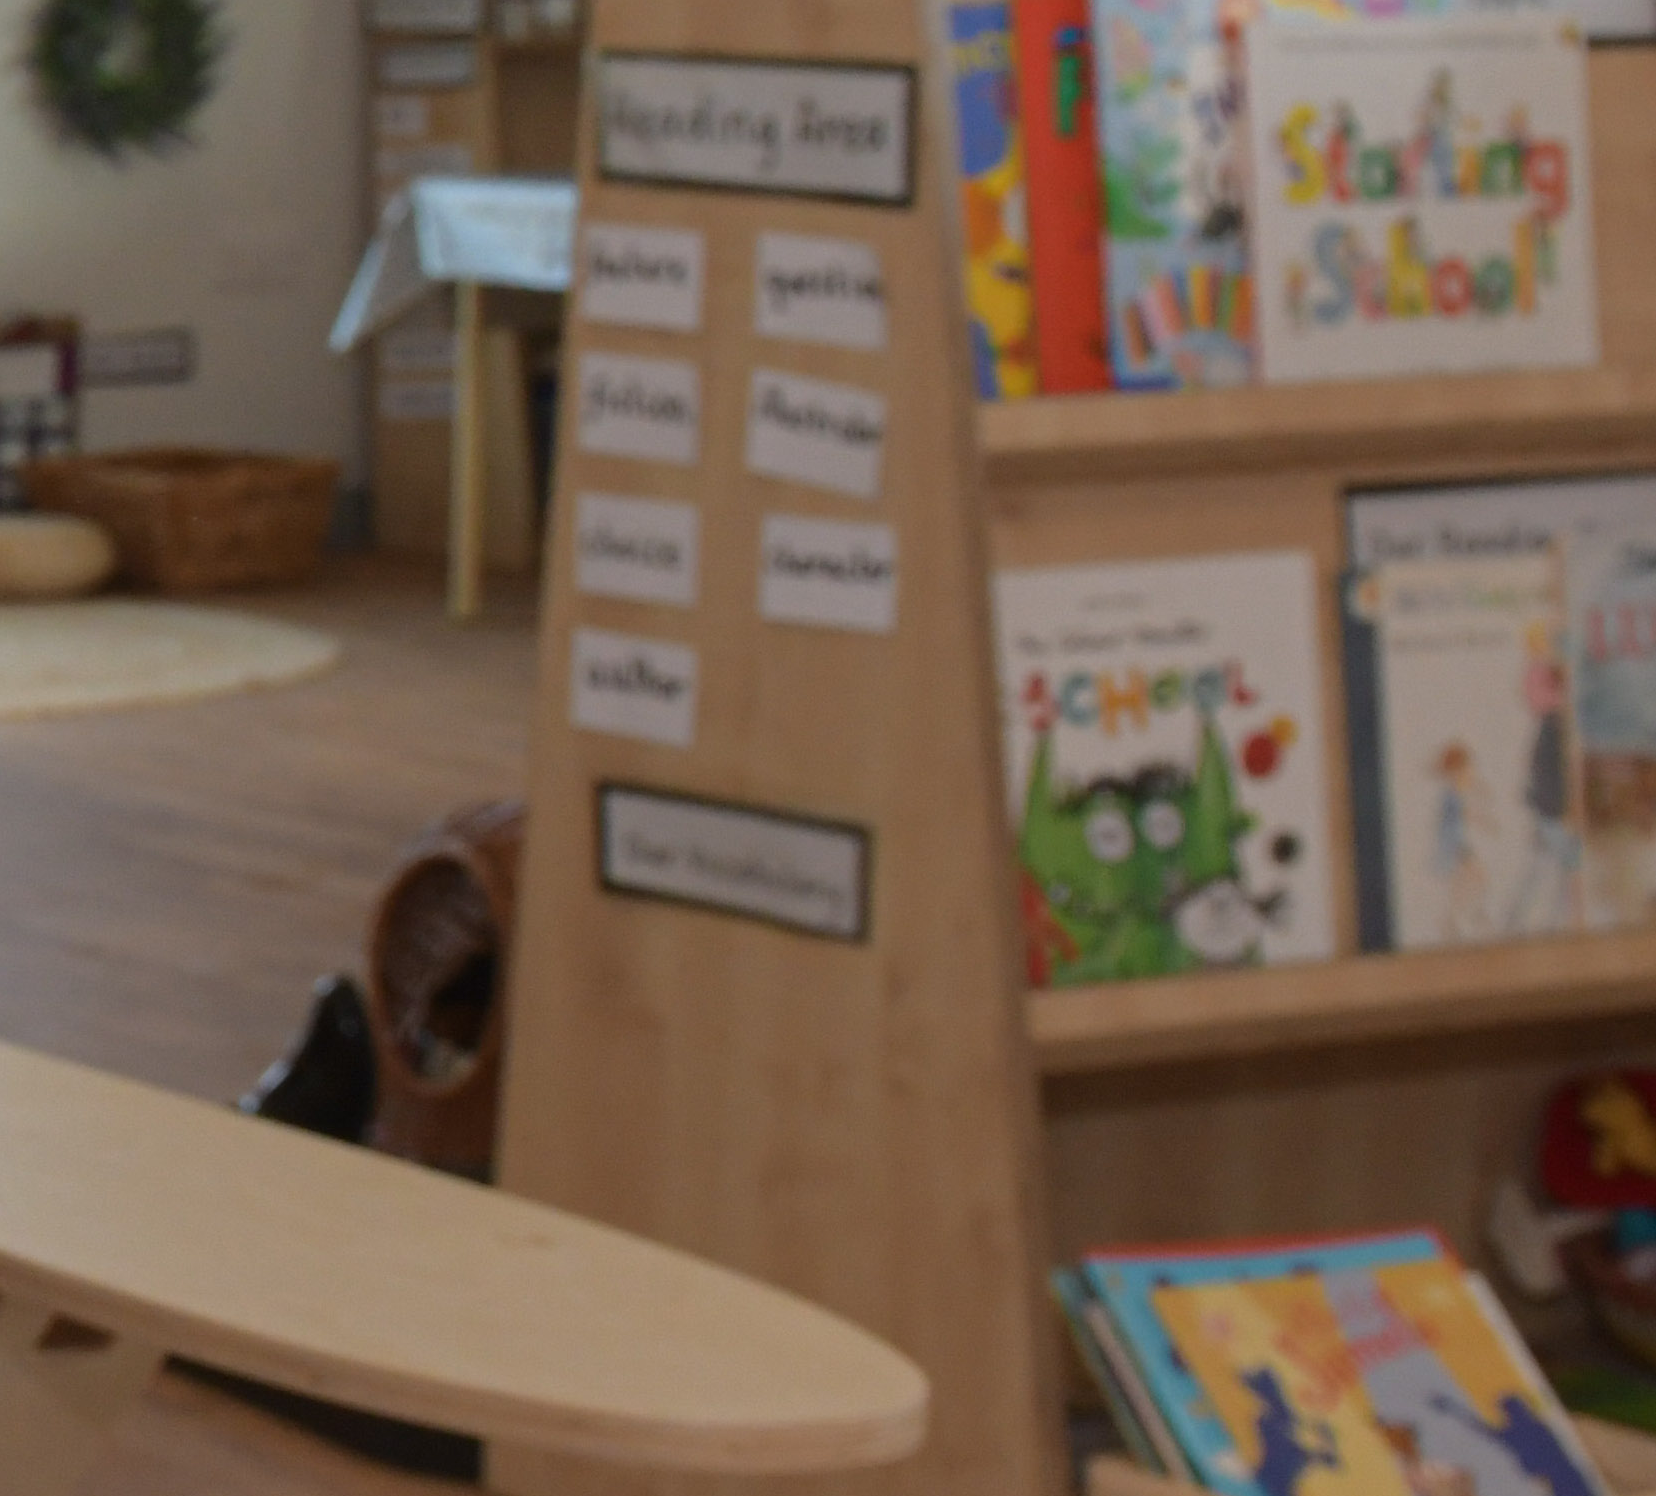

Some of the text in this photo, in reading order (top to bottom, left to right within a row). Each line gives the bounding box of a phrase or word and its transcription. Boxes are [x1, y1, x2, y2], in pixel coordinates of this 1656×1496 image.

[1275, 83, 1571, 221] Starting
[1311, 215, 1539, 326] School
[1020, 656, 1261, 739] SCHOOL
